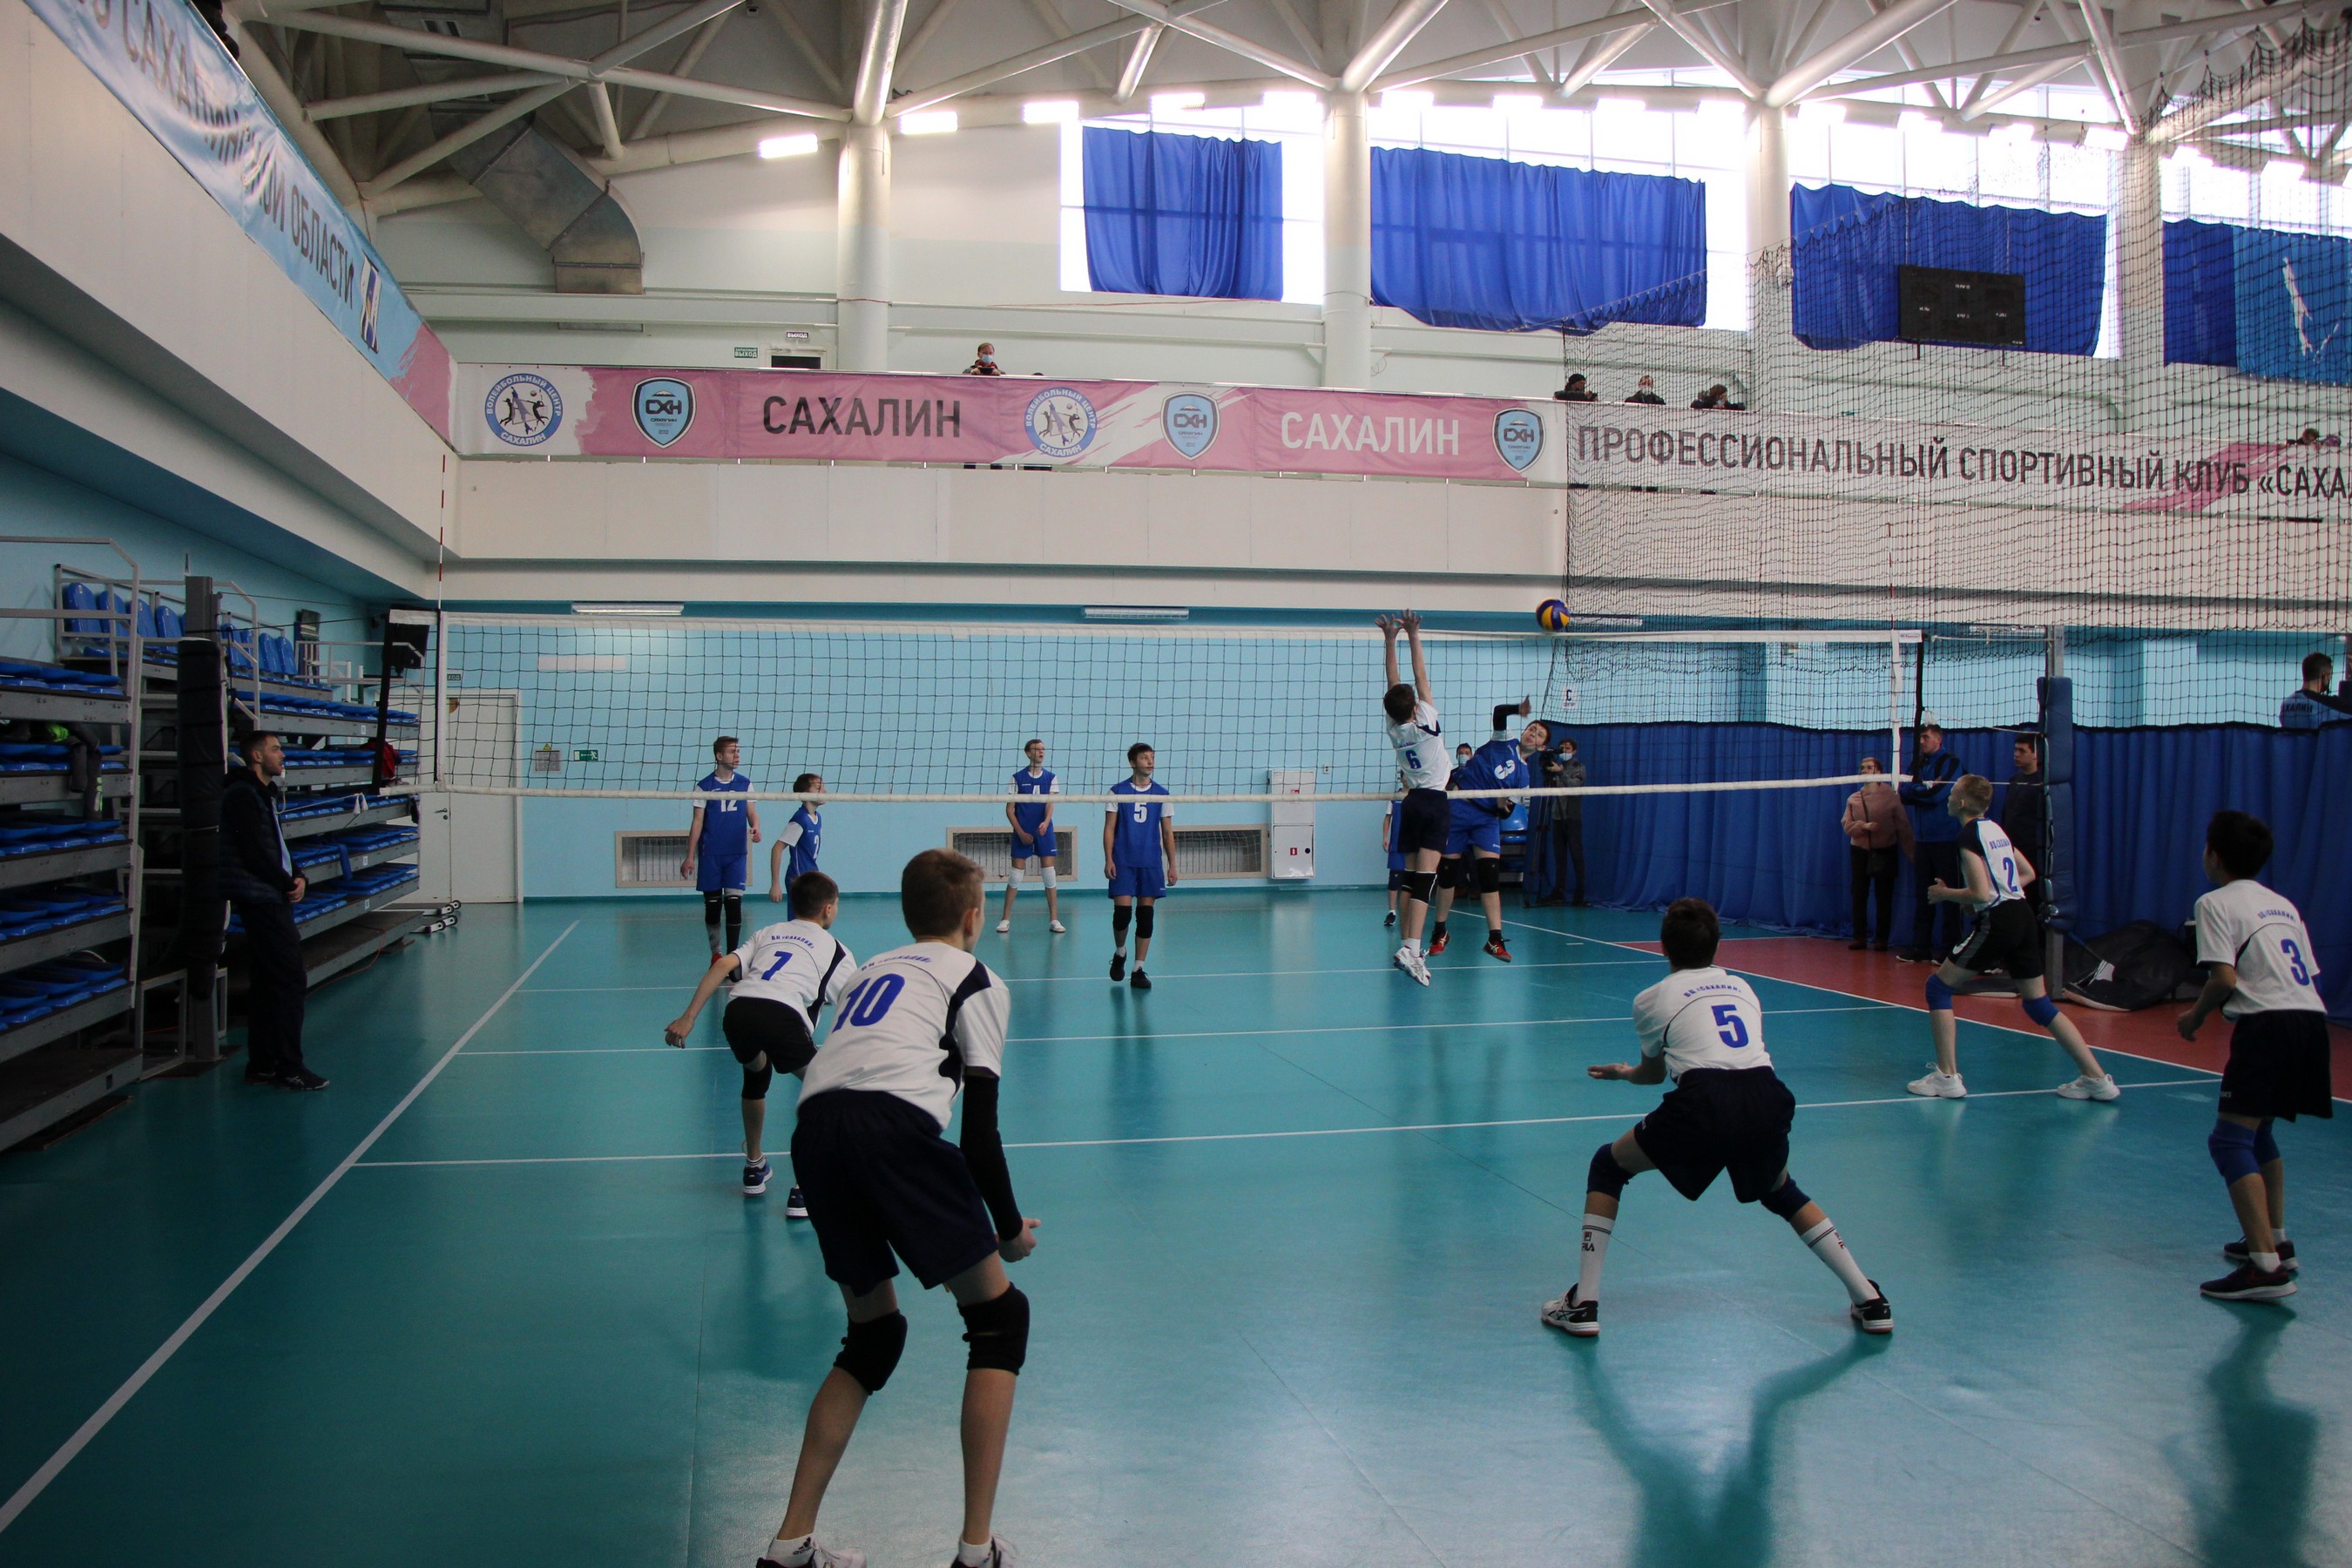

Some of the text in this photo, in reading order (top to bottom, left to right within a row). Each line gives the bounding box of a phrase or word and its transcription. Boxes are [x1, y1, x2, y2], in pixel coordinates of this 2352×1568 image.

[123, 0, 355, 310] САХАЛИНОЙ ОБЛАСТИ
[486, 374, 562, 417] ВОЛЕЙБОЛЬНЫЙ ЦЕНТР
[1025, 389, 1097, 429] ВОЛЕЙБОЛЬНЫЙ ЦЕНТР
[763, 395, 961, 438] САХАЛИН
[1281, 411, 1459, 456] САХАЛИН
[500, 432, 547, 446] САХАЛИН
[1039, 443, 1083, 457] САХАЛИН
[1578, 425, 2352, 499] ПРОФЕССИОНАЛЬНЫЙ СПОРТИВНЫЙ КЛУБ «САХА
[2285, 702, 2313, 713] ХАЛИН
[1405, 749, 1422, 769] 6
[1494, 759, 1516, 780] 3
[720, 790, 738, 812] 12
[1133, 801, 1147, 823] 5
[2003, 857, 2018, 893] 2
[760, 950, 793, 981] 7
[2281, 938, 2310, 986] 3
[831, 973, 905, 1034] 10
[1711, 1004, 1749, 1048] 5
